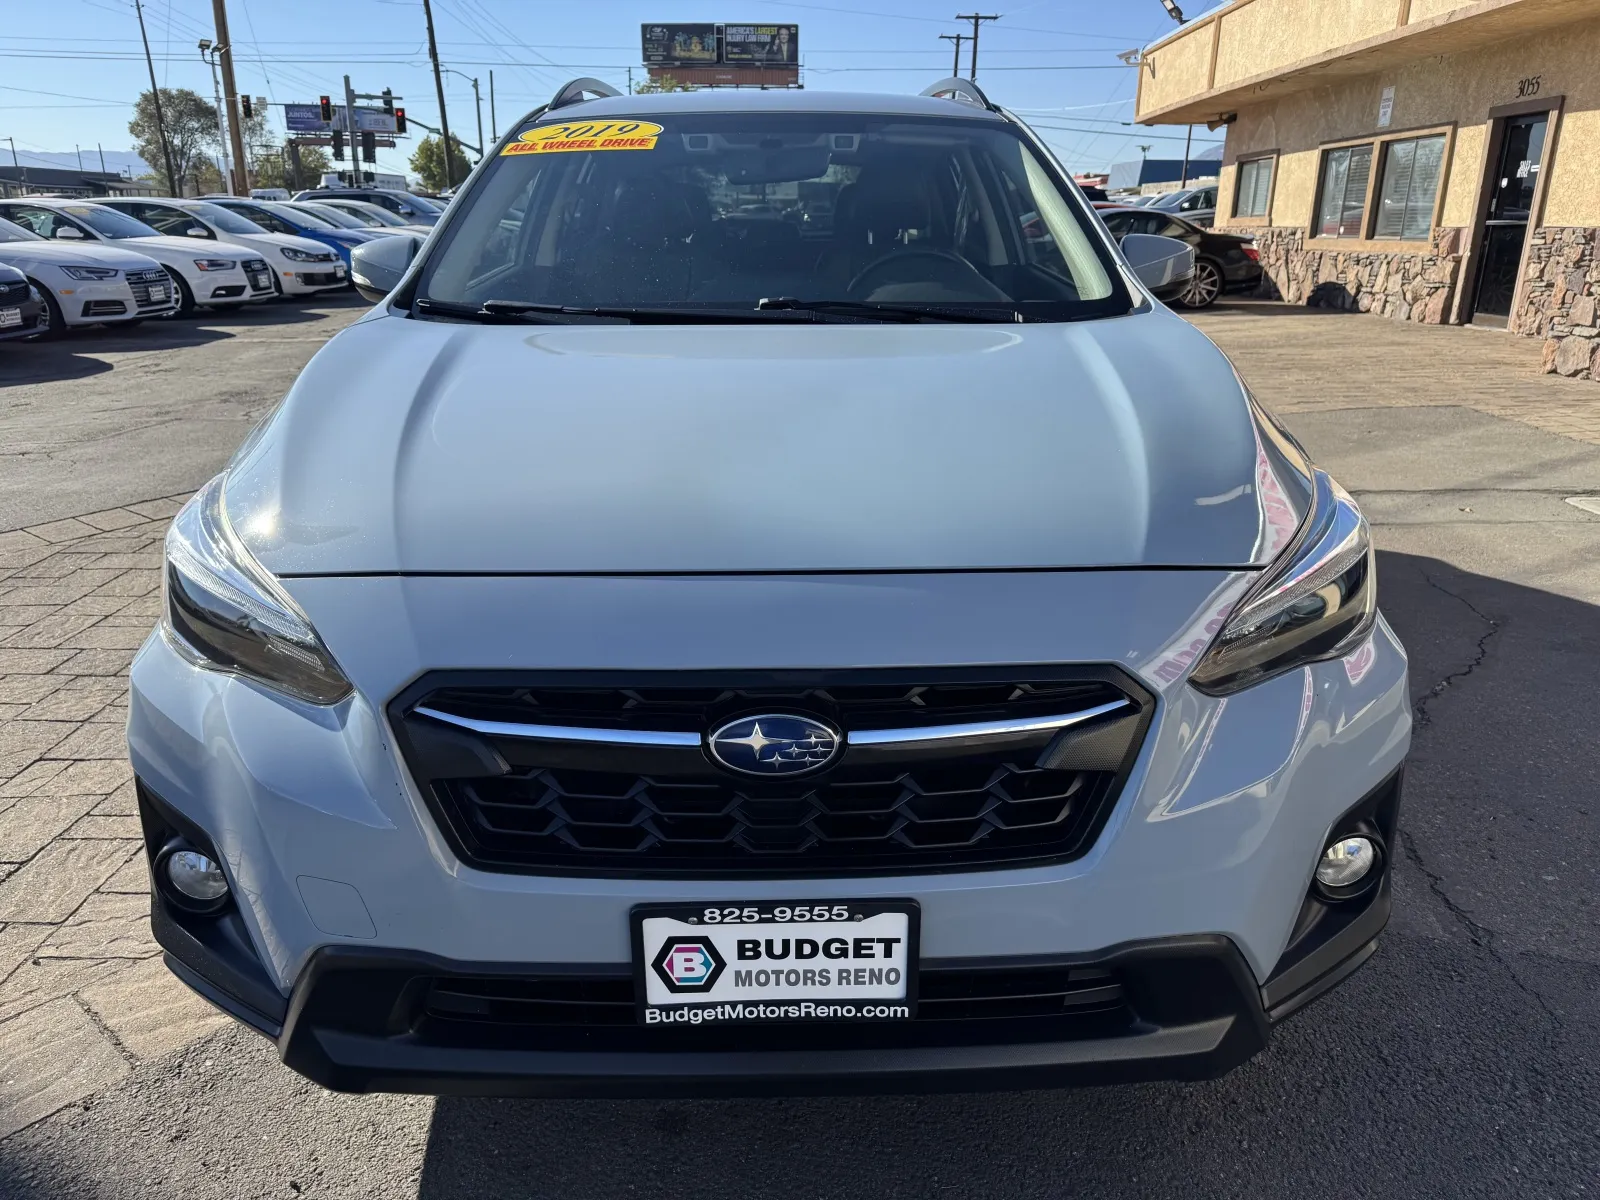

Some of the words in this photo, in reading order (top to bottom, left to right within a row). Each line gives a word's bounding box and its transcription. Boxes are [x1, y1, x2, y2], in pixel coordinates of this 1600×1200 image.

[745, 34, 757, 42] LAW
[758, 34, 771, 42] FIRM
[755, 26, 778, 35] LARGEST
[1515, 75, 1542, 98] 3055
[540, 123, 640, 140] 2019
[506, 142, 537, 153] ALL
[542, 139, 597, 150] WHEEL
[600, 138, 653, 148] DRIVE
[703, 906, 849, 923] 825-9555
[736, 938, 901, 960] BUDGET
[673, 951, 707, 977] B
[734, 968, 831, 987] MOTORS
[837, 967, 900, 986] RENO
[645, 1003, 909, 1024] BudgetMotorsReno.com
